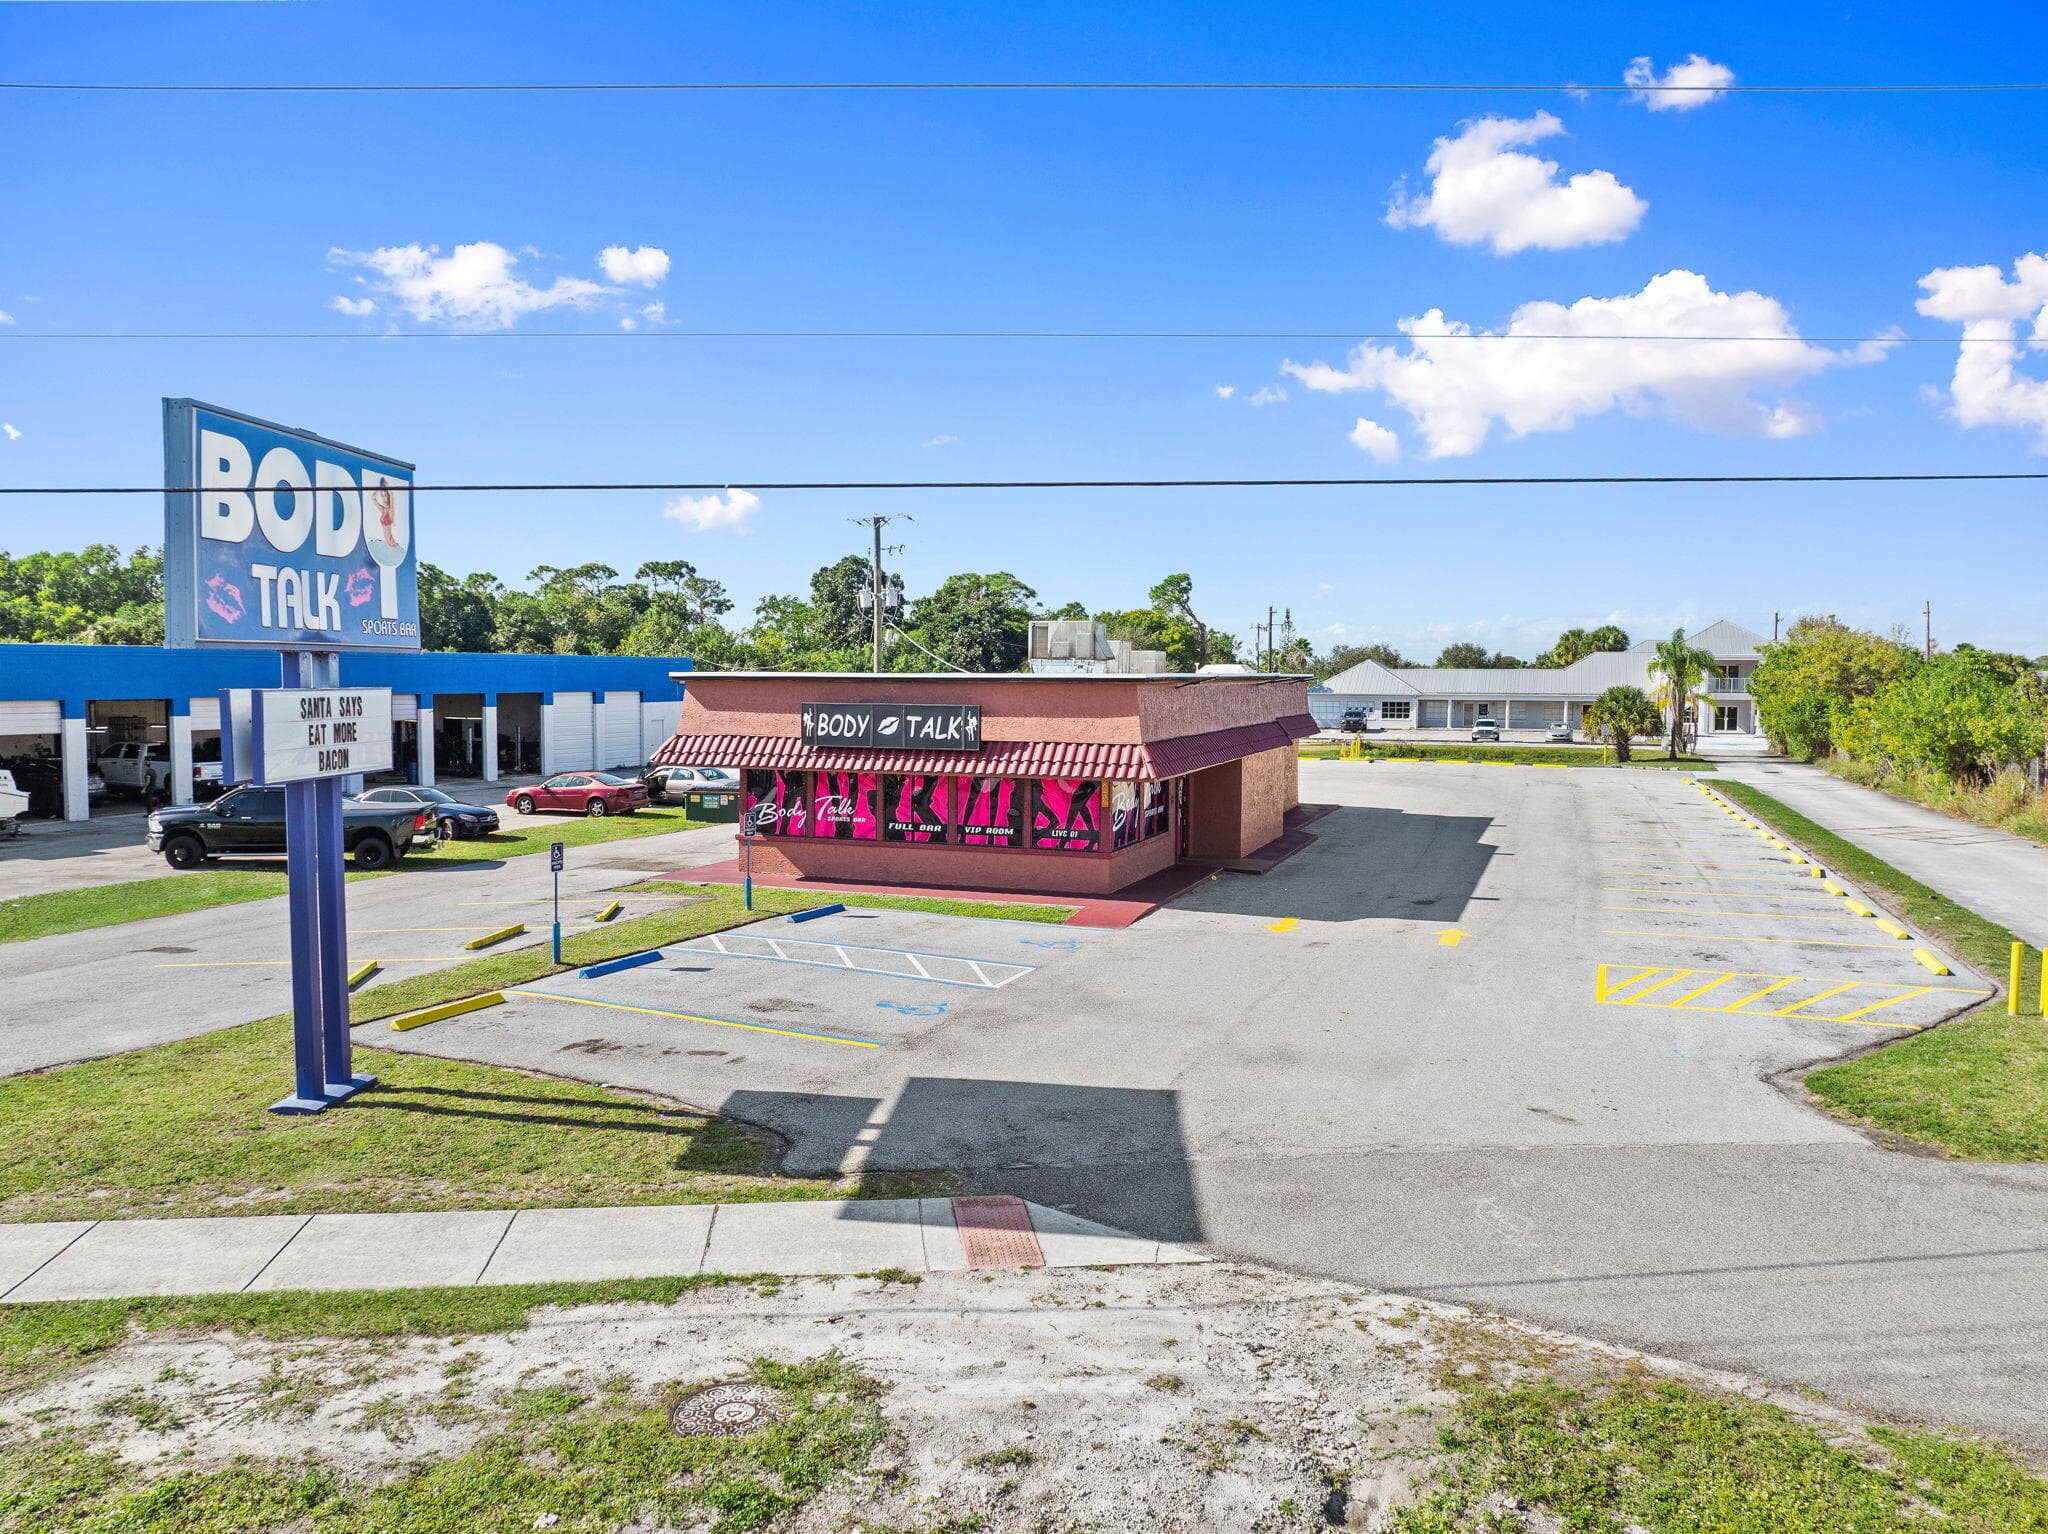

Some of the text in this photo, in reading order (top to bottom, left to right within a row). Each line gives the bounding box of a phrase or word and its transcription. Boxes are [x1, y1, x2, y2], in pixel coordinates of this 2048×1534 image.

[201, 429, 410, 619] BODY
[252, 563, 341, 631] TALK
[362, 619, 417, 637] SPORTS BAR
[300, 696, 363, 719] SANTA SAYS
[308, 722, 357, 746] EAT MORE
[817, 713, 962, 740] BODY TALK
[319, 748, 349, 772] BACON
[754, 795, 855, 829] Body Talk
[888, 822, 942, 832] FULL BAR
[964, 826, 1014, 836] VIP ROOM
[1051, 829, 1068, 838] LIVE
